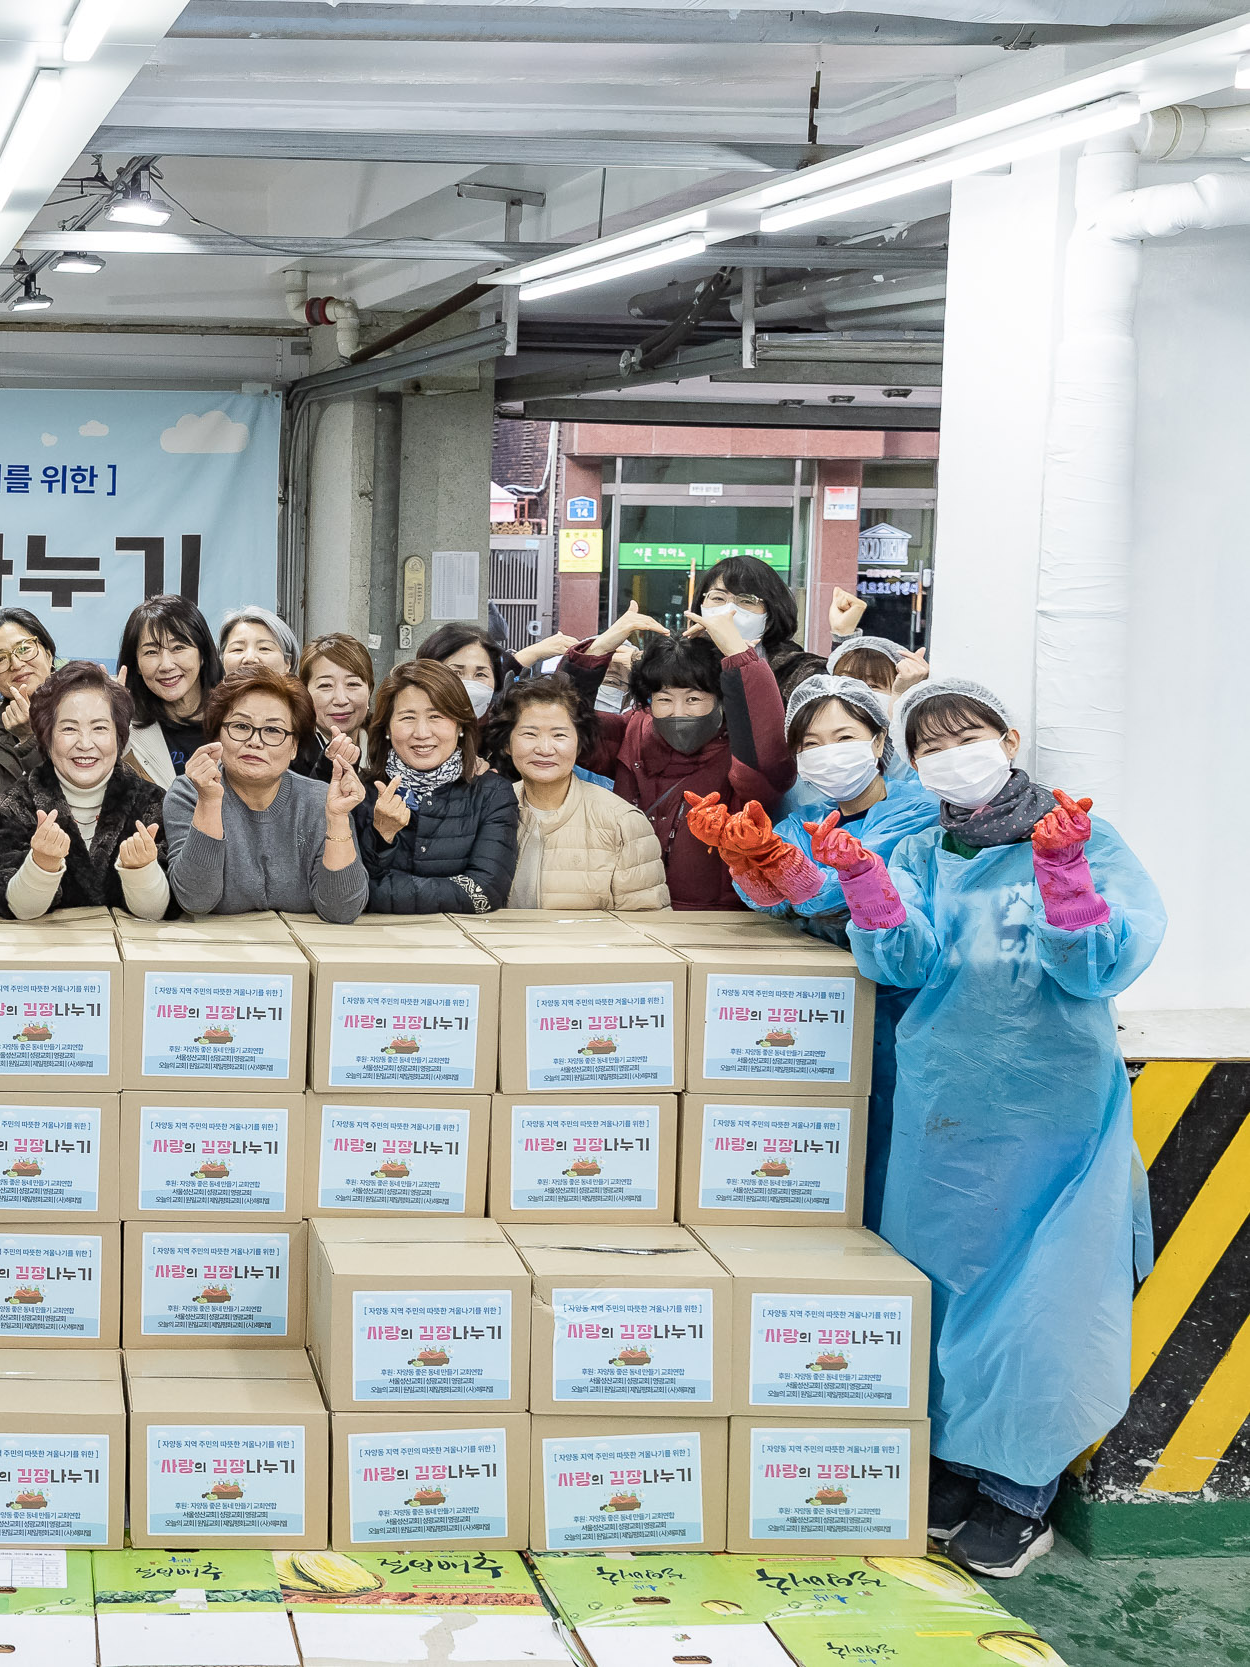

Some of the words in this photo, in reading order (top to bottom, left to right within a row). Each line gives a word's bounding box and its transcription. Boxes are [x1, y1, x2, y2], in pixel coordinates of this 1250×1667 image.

[40, 464, 99, 495] 위한
[576, 508, 589, 517] 14
[23, 1003, 100, 1016] 김장나누기
[719, 1007, 762, 1021] 사랑의
[767, 1008, 844, 1023] 김장나누기
[344, 1015, 387, 1029] 사랑의
[392, 1016, 468, 1030] 김장나누기
[153, 1139, 195, 1153] 사랑의
[201, 1140, 278, 1154] 김장나누기
[334, 1138, 376, 1153] 사랑의
[382, 1140, 459, 1155] 김장나누기
[715, 1137, 757, 1152] 사랑의
[763, 1139, 839, 1154] 김장나누기
[155, 1265, 197, 1278] 사랑의
[203, 1265, 279, 1279] 김장나누기
[567, 1324, 613, 1339] 사랑의
[620, 1324, 703, 1339] 김장나누기
[765, 1328, 811, 1344] 사랑의
[818, 1330, 901, 1345] 김장나누기
[184, 1440, 197, 1448] 지역
[200, 1440, 218, 1448] 주민의
[161, 1459, 206, 1474] 사랑의
[213, 1459, 294, 1473] 김장나누기
[363, 1466, 408, 1482] 사랑의
[415, 1463, 496, 1480] 김장나누기
[765, 1464, 810, 1479] 사랑의
[817, 1464, 899, 1479] 김장나누기
[17, 1469, 99, 1483] 김장나누기
[134, 1562, 223, 1581] 절임배추
[376, 1552, 503, 1579] 절임배추
[596, 1566, 686, 1586] 절임배추
[756, 1568, 887, 1596] 절임배추
